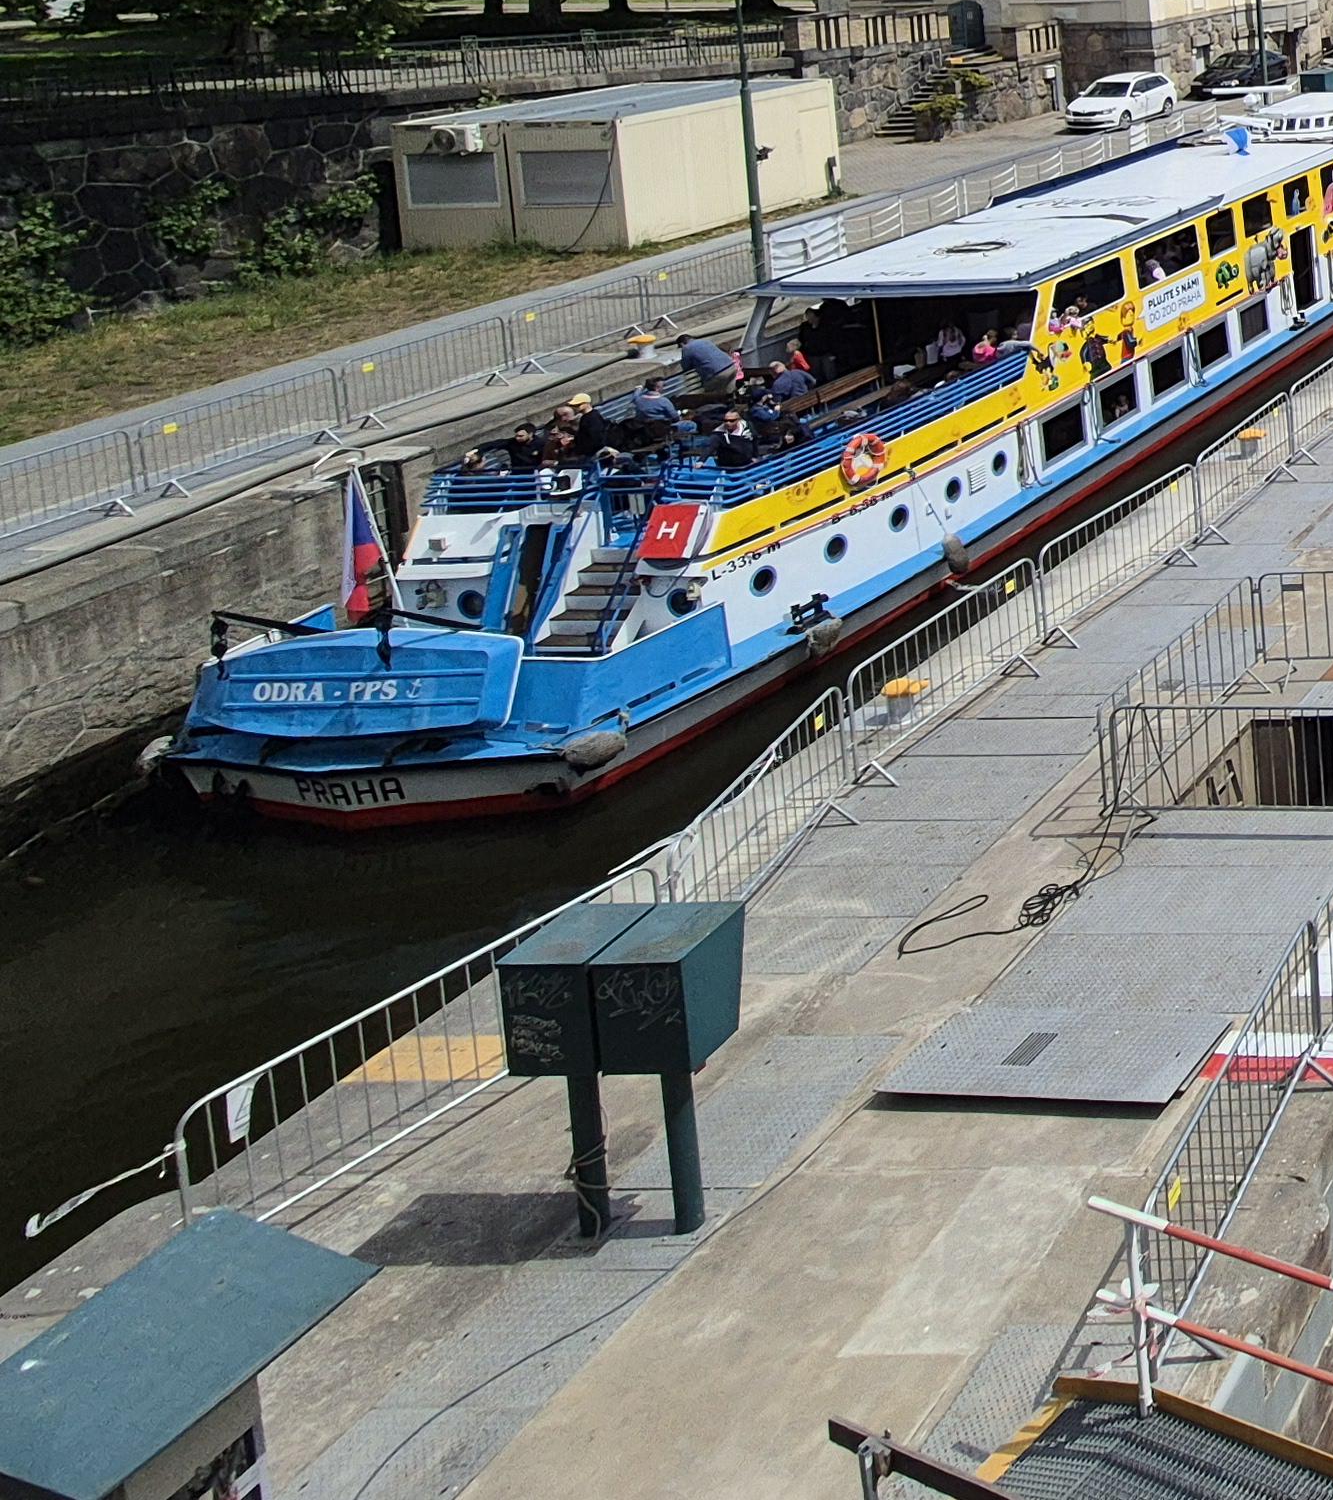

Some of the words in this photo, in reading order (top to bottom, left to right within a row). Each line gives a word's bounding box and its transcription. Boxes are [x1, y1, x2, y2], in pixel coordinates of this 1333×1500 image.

[1148, 287, 1176, 310] PLUJTE
[1181, 277, 1200, 293] NÁMI
[1149, 309, 1162, 324] DO
[1162, 301, 1177, 318] ZOO
[1178, 290, 1202, 309] PRAHA
[656, 520, 681, 540] H
[253, 681, 325, 702] ODRA
[349, 679, 398, 701] PPS
[295, 776, 406, 806] PRAHA
